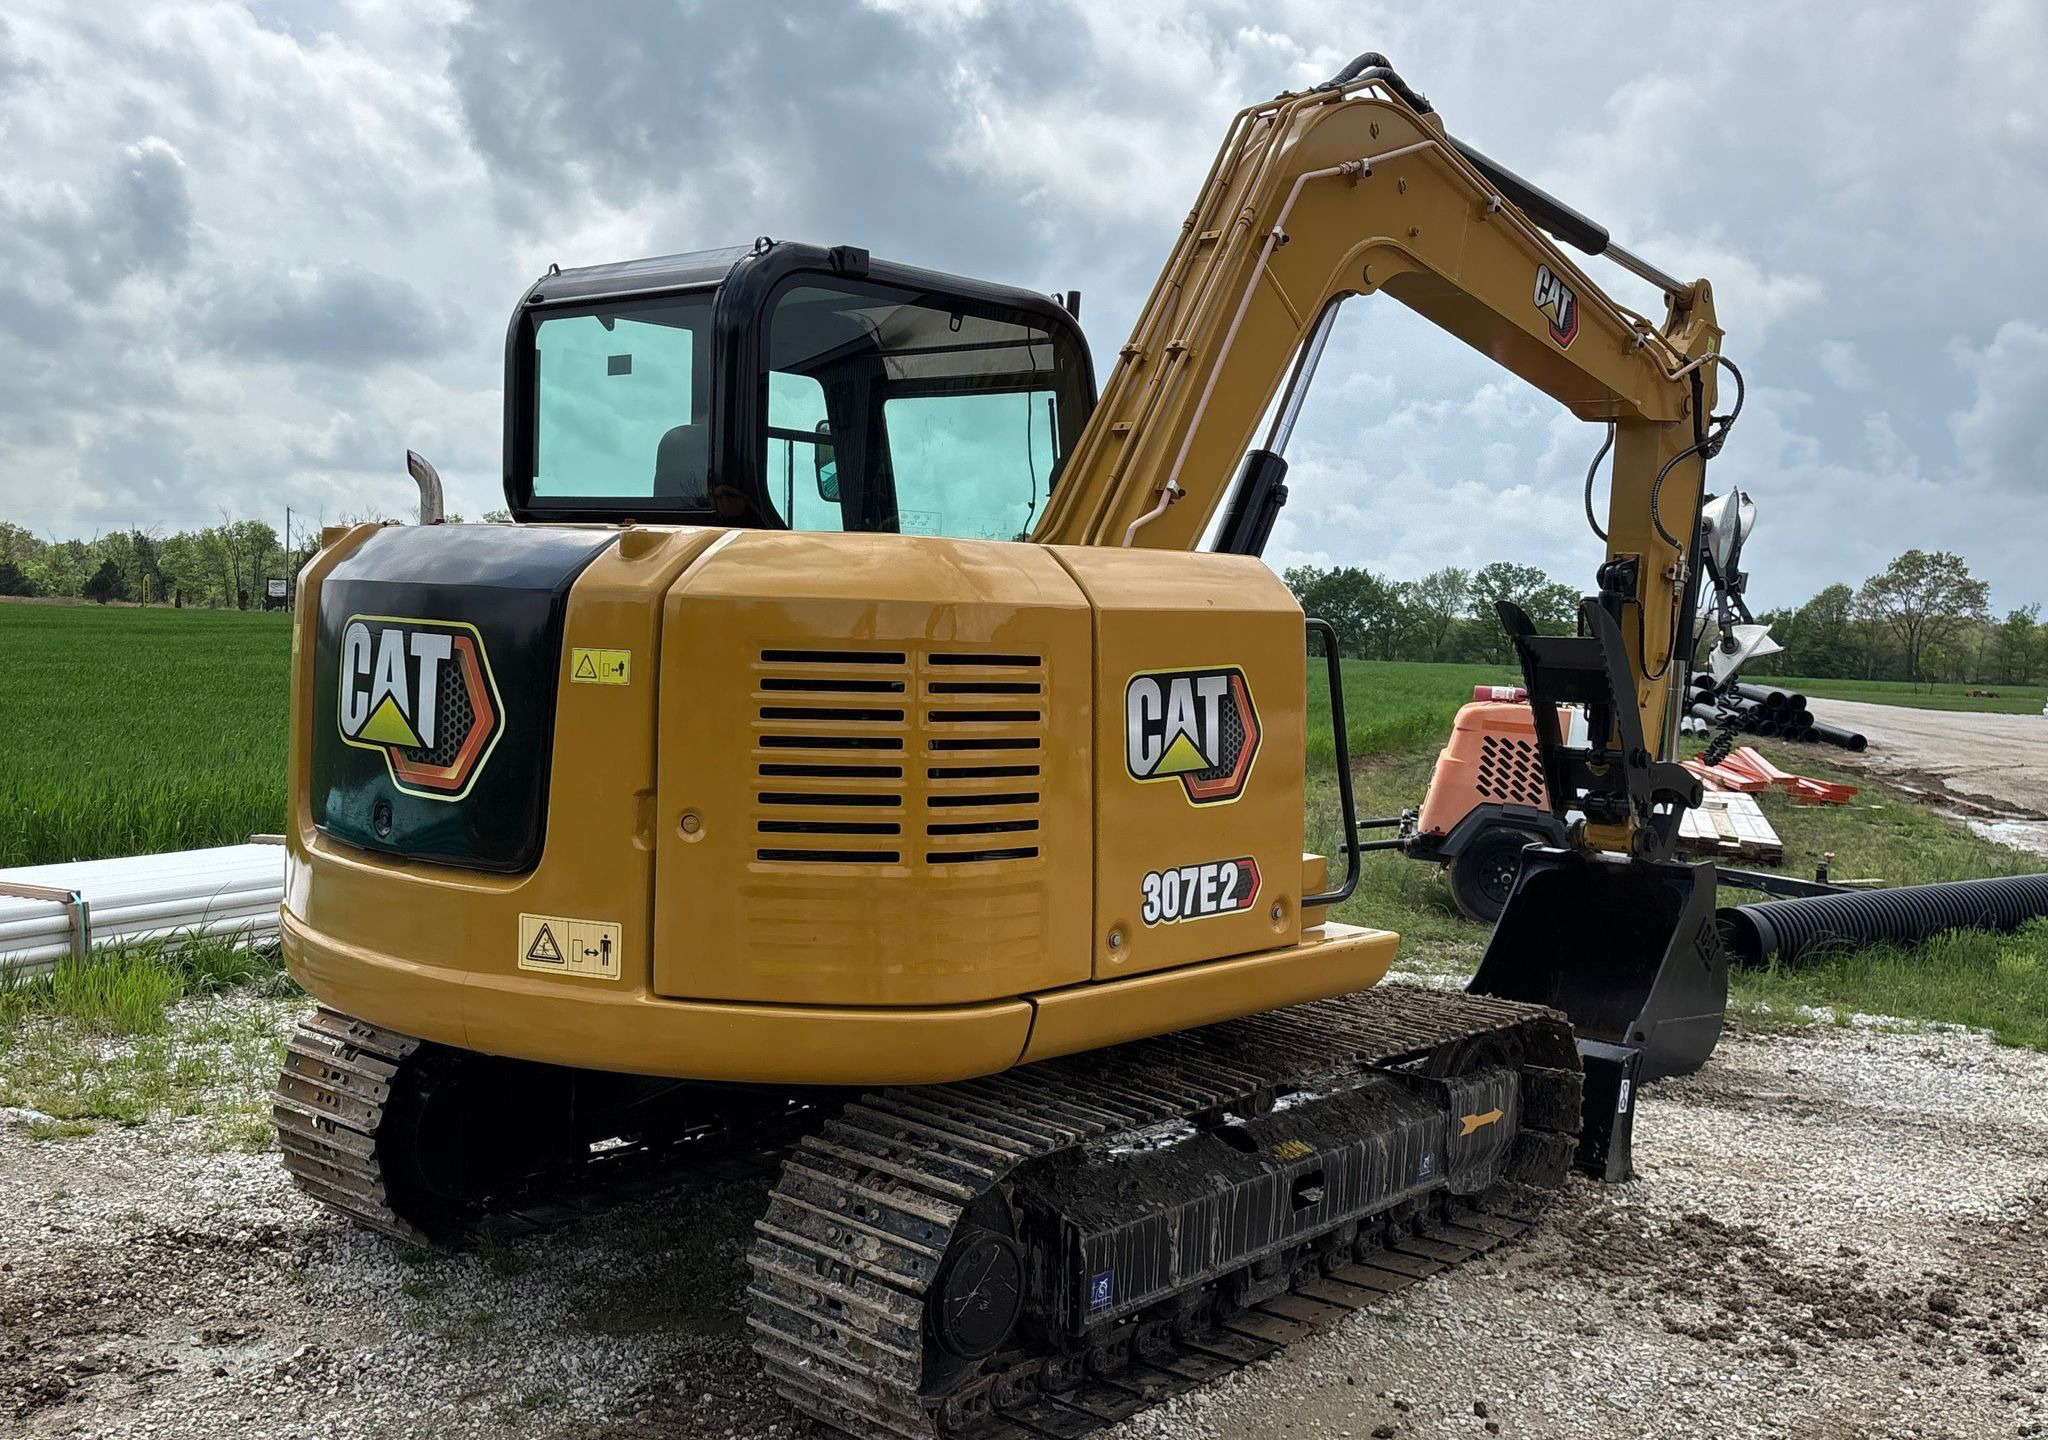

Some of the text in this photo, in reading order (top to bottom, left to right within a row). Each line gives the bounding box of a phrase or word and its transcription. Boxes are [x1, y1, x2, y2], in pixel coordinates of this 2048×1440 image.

[1533, 264, 1573, 329] CAT
[342, 622, 452, 749] CAT
[1127, 675, 1228, 776] CAT
[1142, 861, 1238, 922] 307E2
